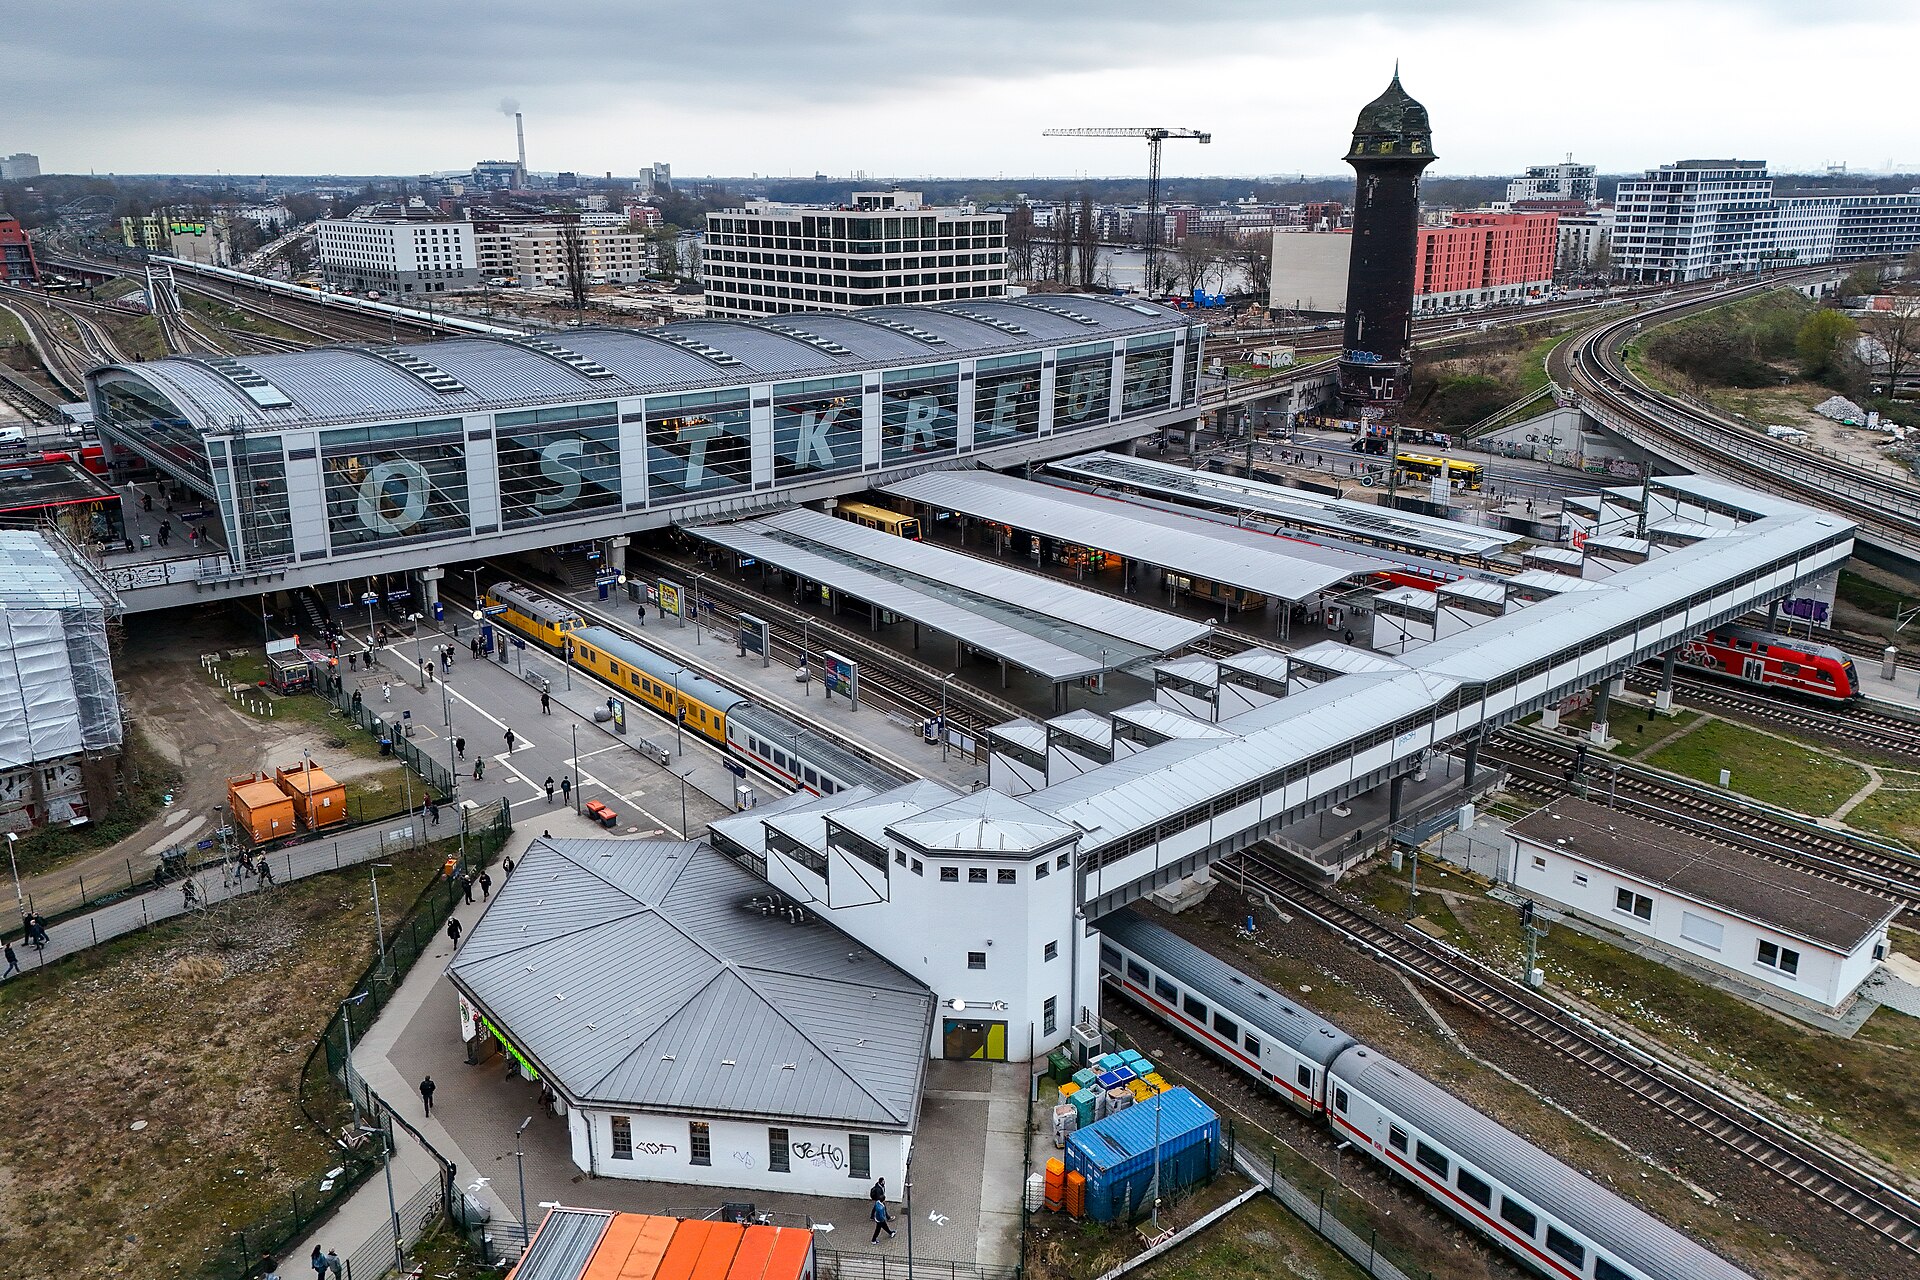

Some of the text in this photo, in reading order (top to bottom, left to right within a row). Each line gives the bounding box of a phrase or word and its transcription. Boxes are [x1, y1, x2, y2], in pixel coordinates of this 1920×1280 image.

[169, 221, 207, 237] 1UP
[1369, 376, 1395, 400] YG
[467, 1177, 491, 1192] WC
[928, 1209, 950, 1226] WC
